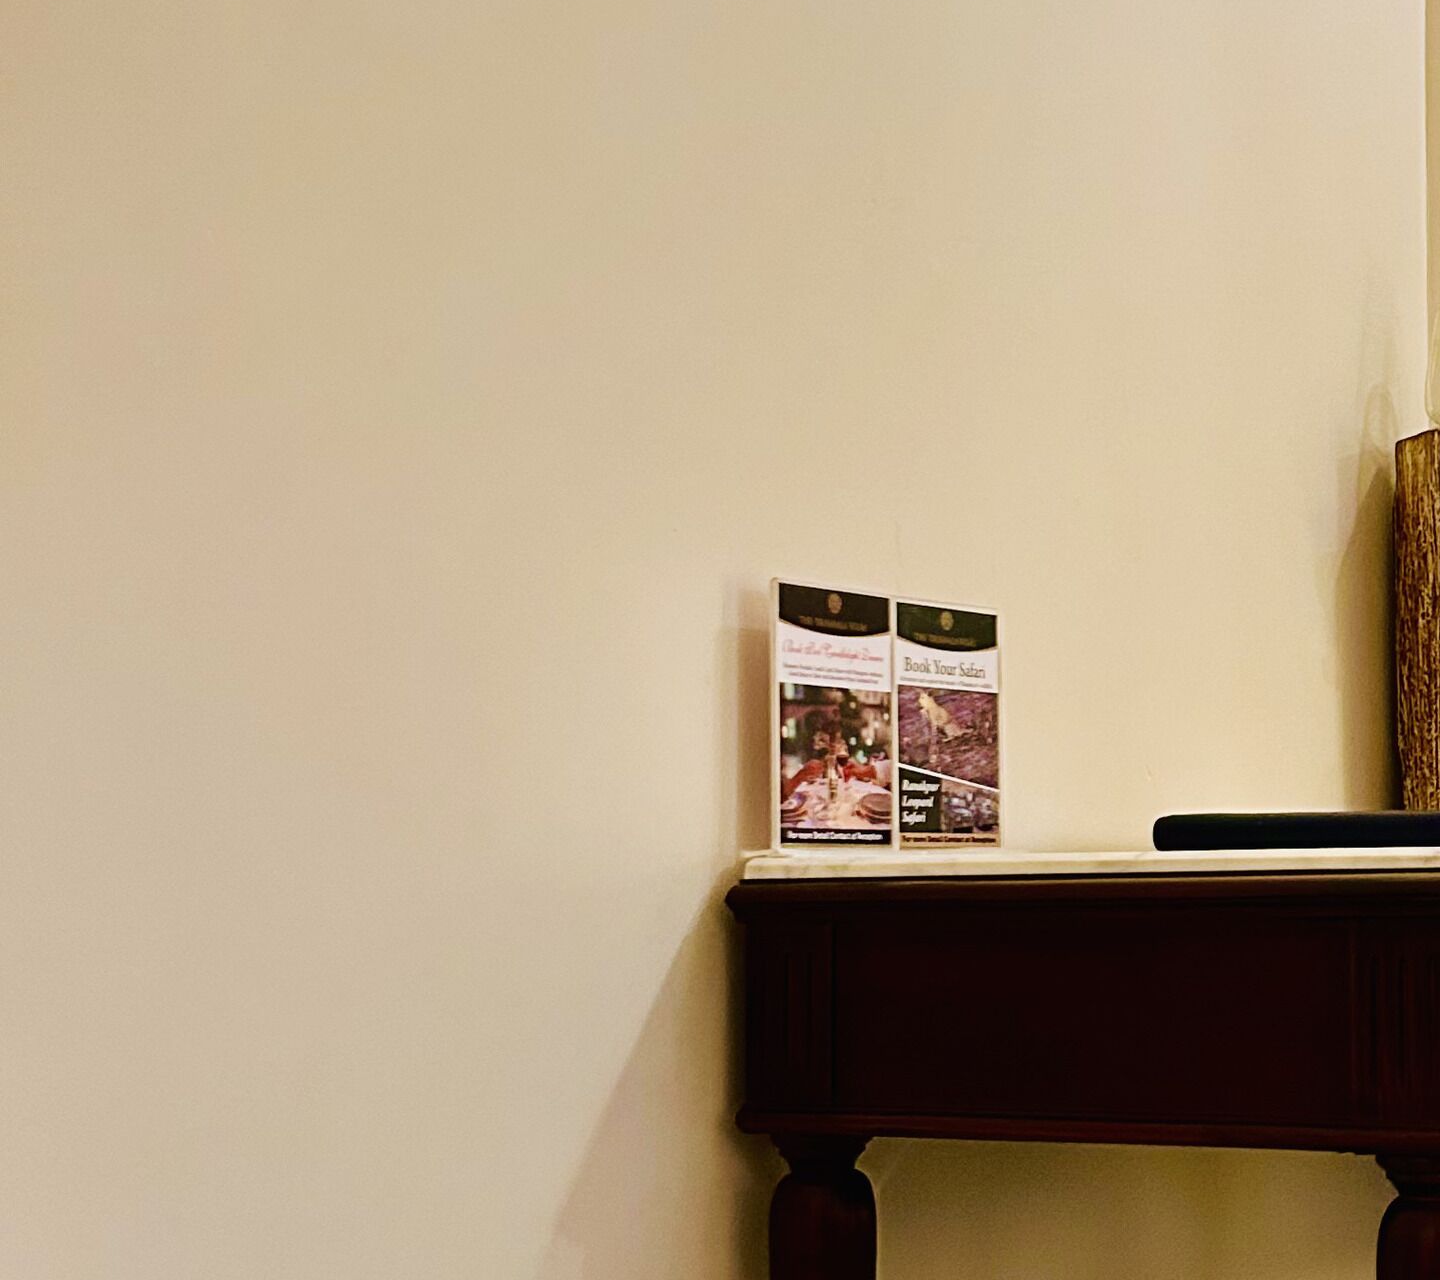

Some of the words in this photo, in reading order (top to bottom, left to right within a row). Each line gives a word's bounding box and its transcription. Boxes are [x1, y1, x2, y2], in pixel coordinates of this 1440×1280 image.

[903, 656, 931, 674] Book
[933, 659, 957, 676] Your
[959, 662, 986, 679] Safari
